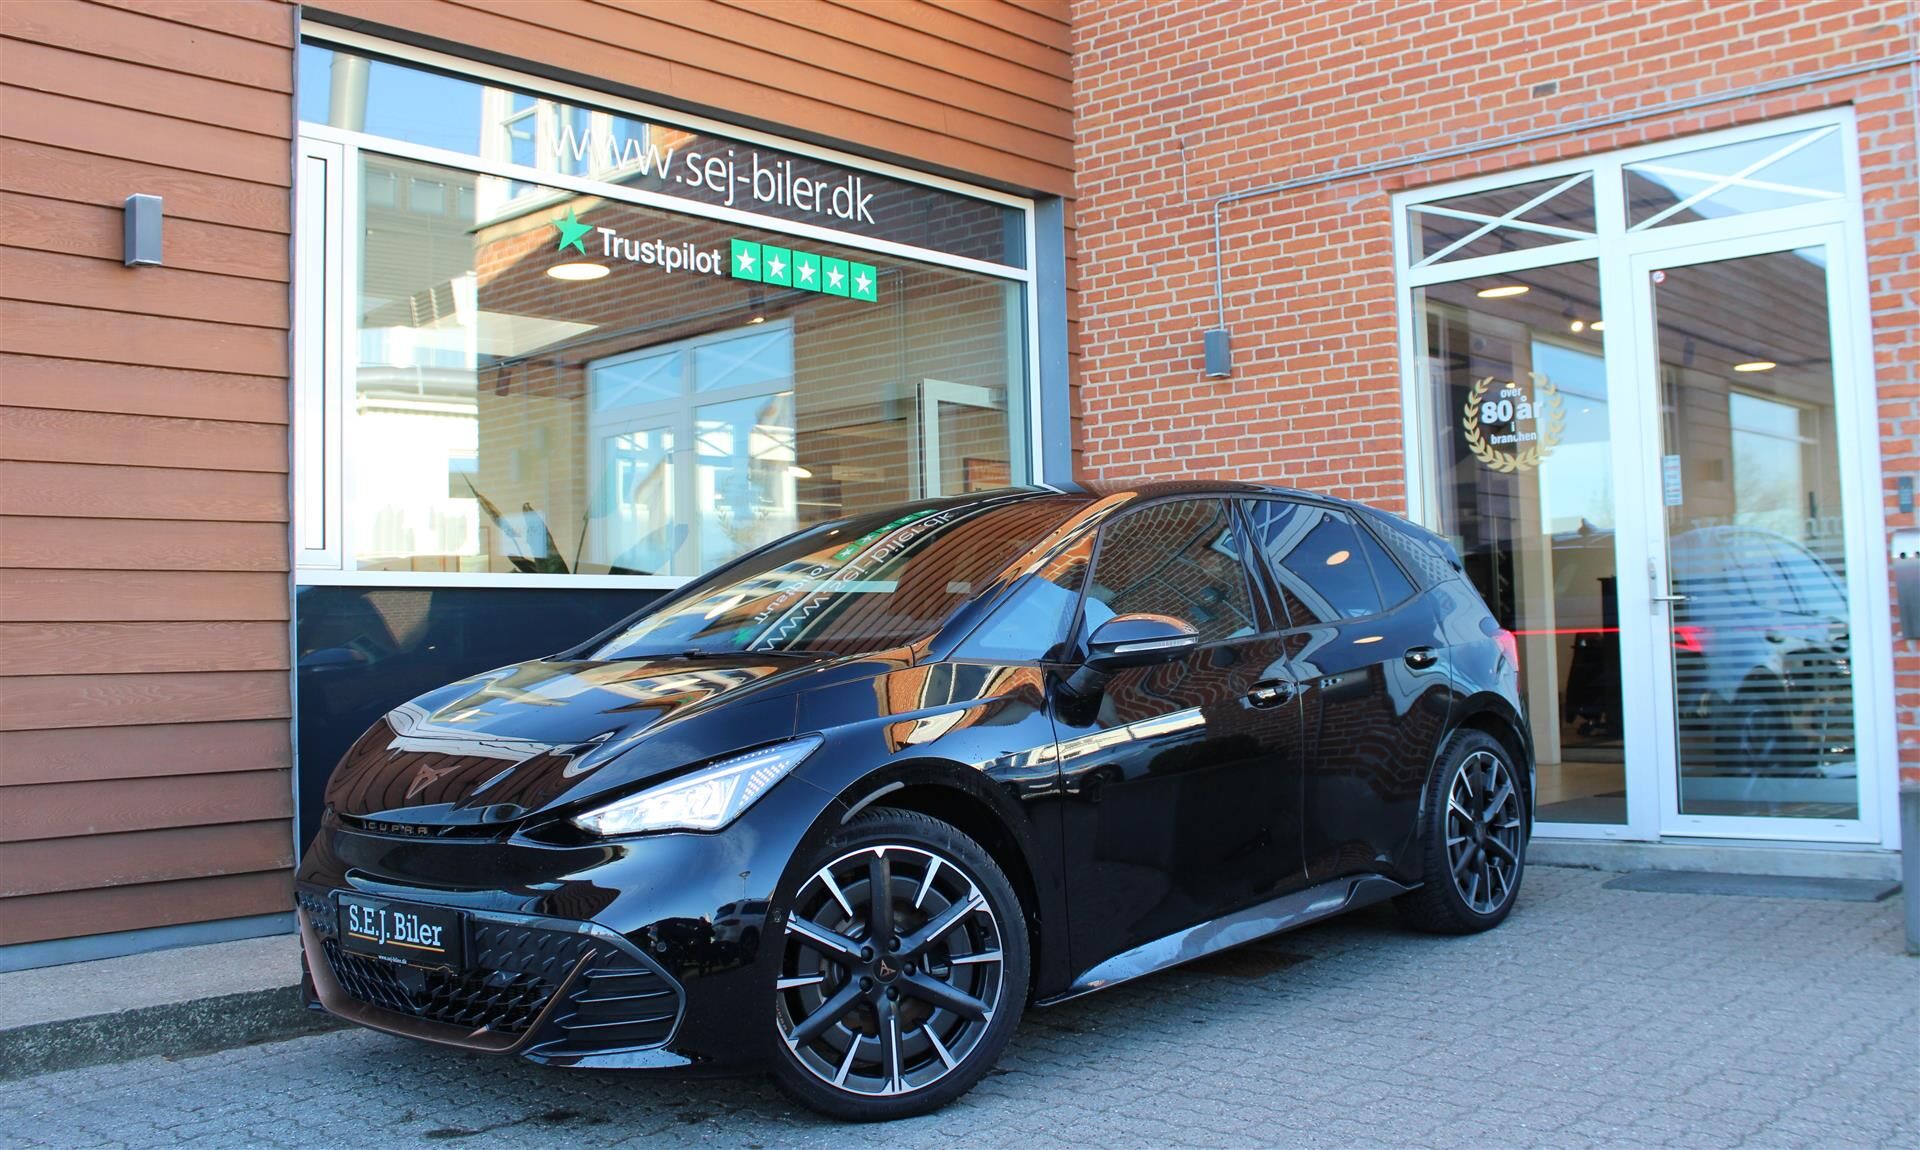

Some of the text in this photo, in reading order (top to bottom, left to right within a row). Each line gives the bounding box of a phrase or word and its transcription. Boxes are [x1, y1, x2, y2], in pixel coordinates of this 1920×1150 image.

[548, 121, 875, 225] www.sej-biler.dk
[597, 226, 722, 277] Trustpilot
[1500, 387, 1523, 398] over
[1481, 395, 1544, 424] 80 år
[1510, 421, 1516, 433] i
[1490, 432, 1537, 445] branchen
[367, 822, 429, 835] CUPRA
[349, 904, 442, 946] S.E.J. Biler
